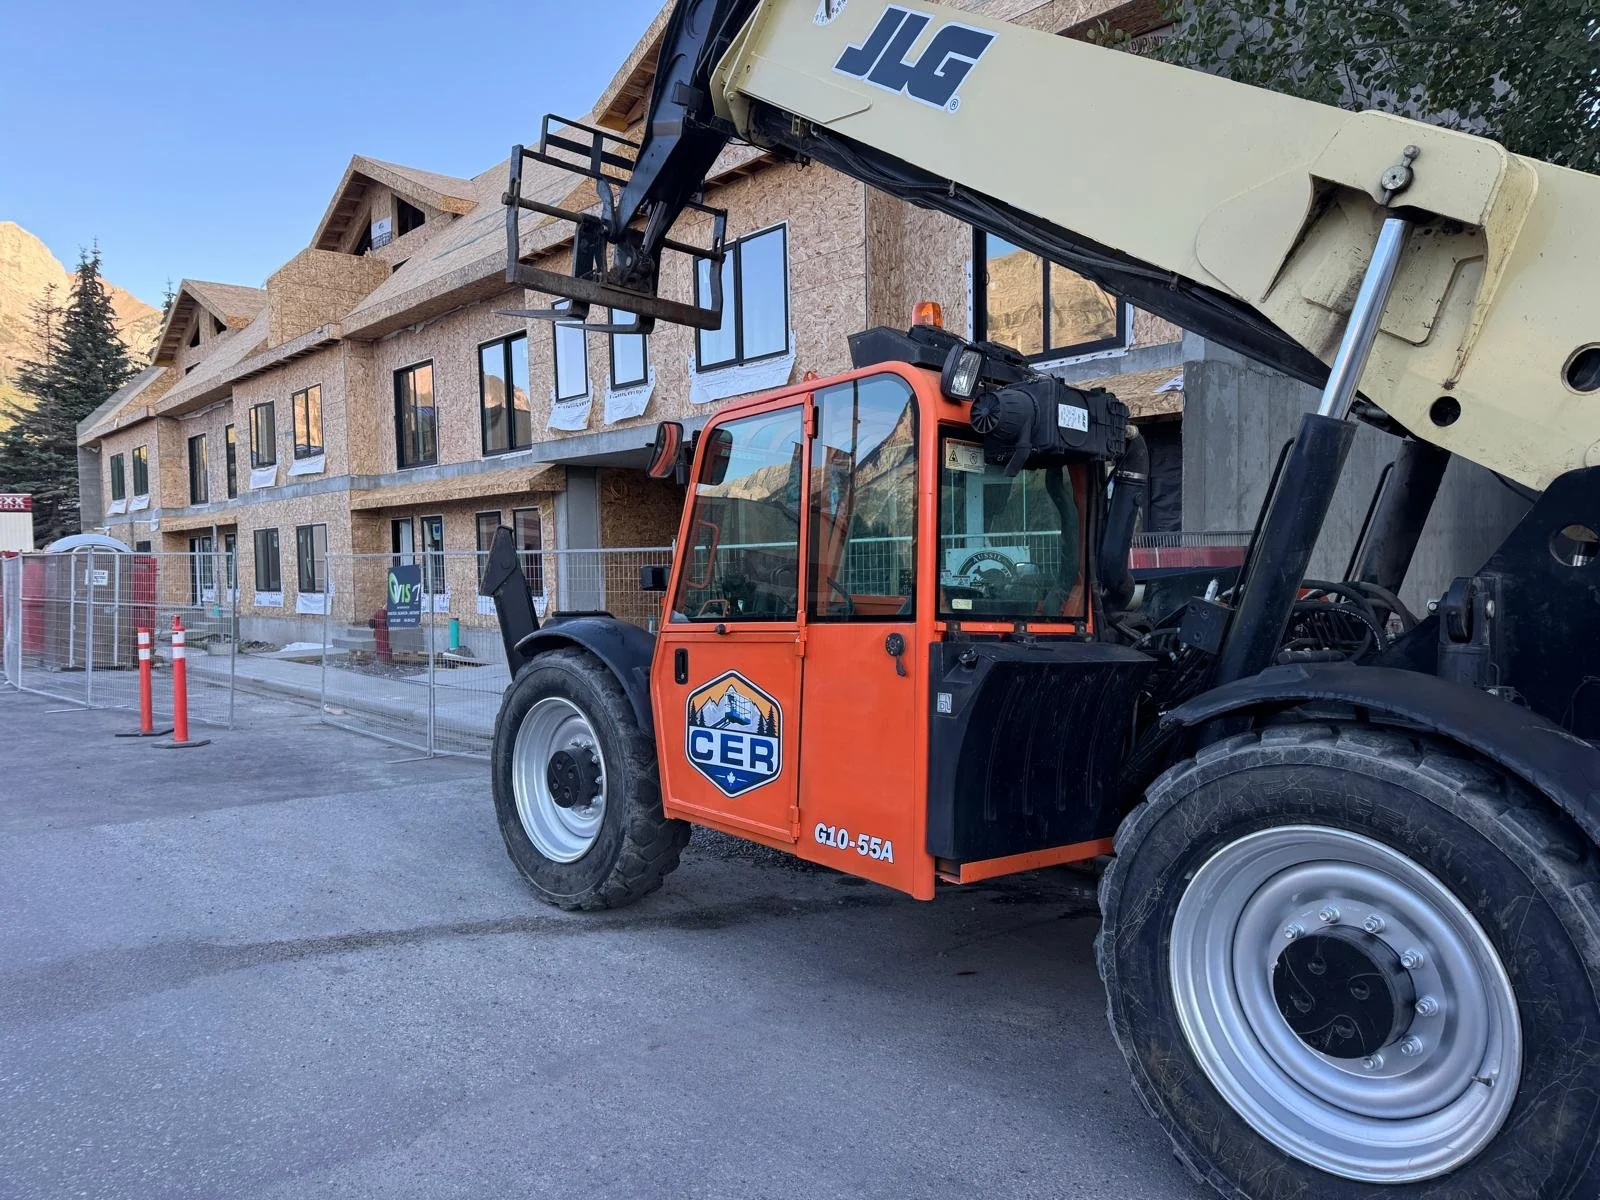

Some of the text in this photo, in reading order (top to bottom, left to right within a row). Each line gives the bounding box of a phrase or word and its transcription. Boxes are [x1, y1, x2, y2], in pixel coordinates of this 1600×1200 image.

[833, 5, 998, 110] JLG
[690, 729, 775, 773] CER
[814, 821, 895, 865] G10-55A
